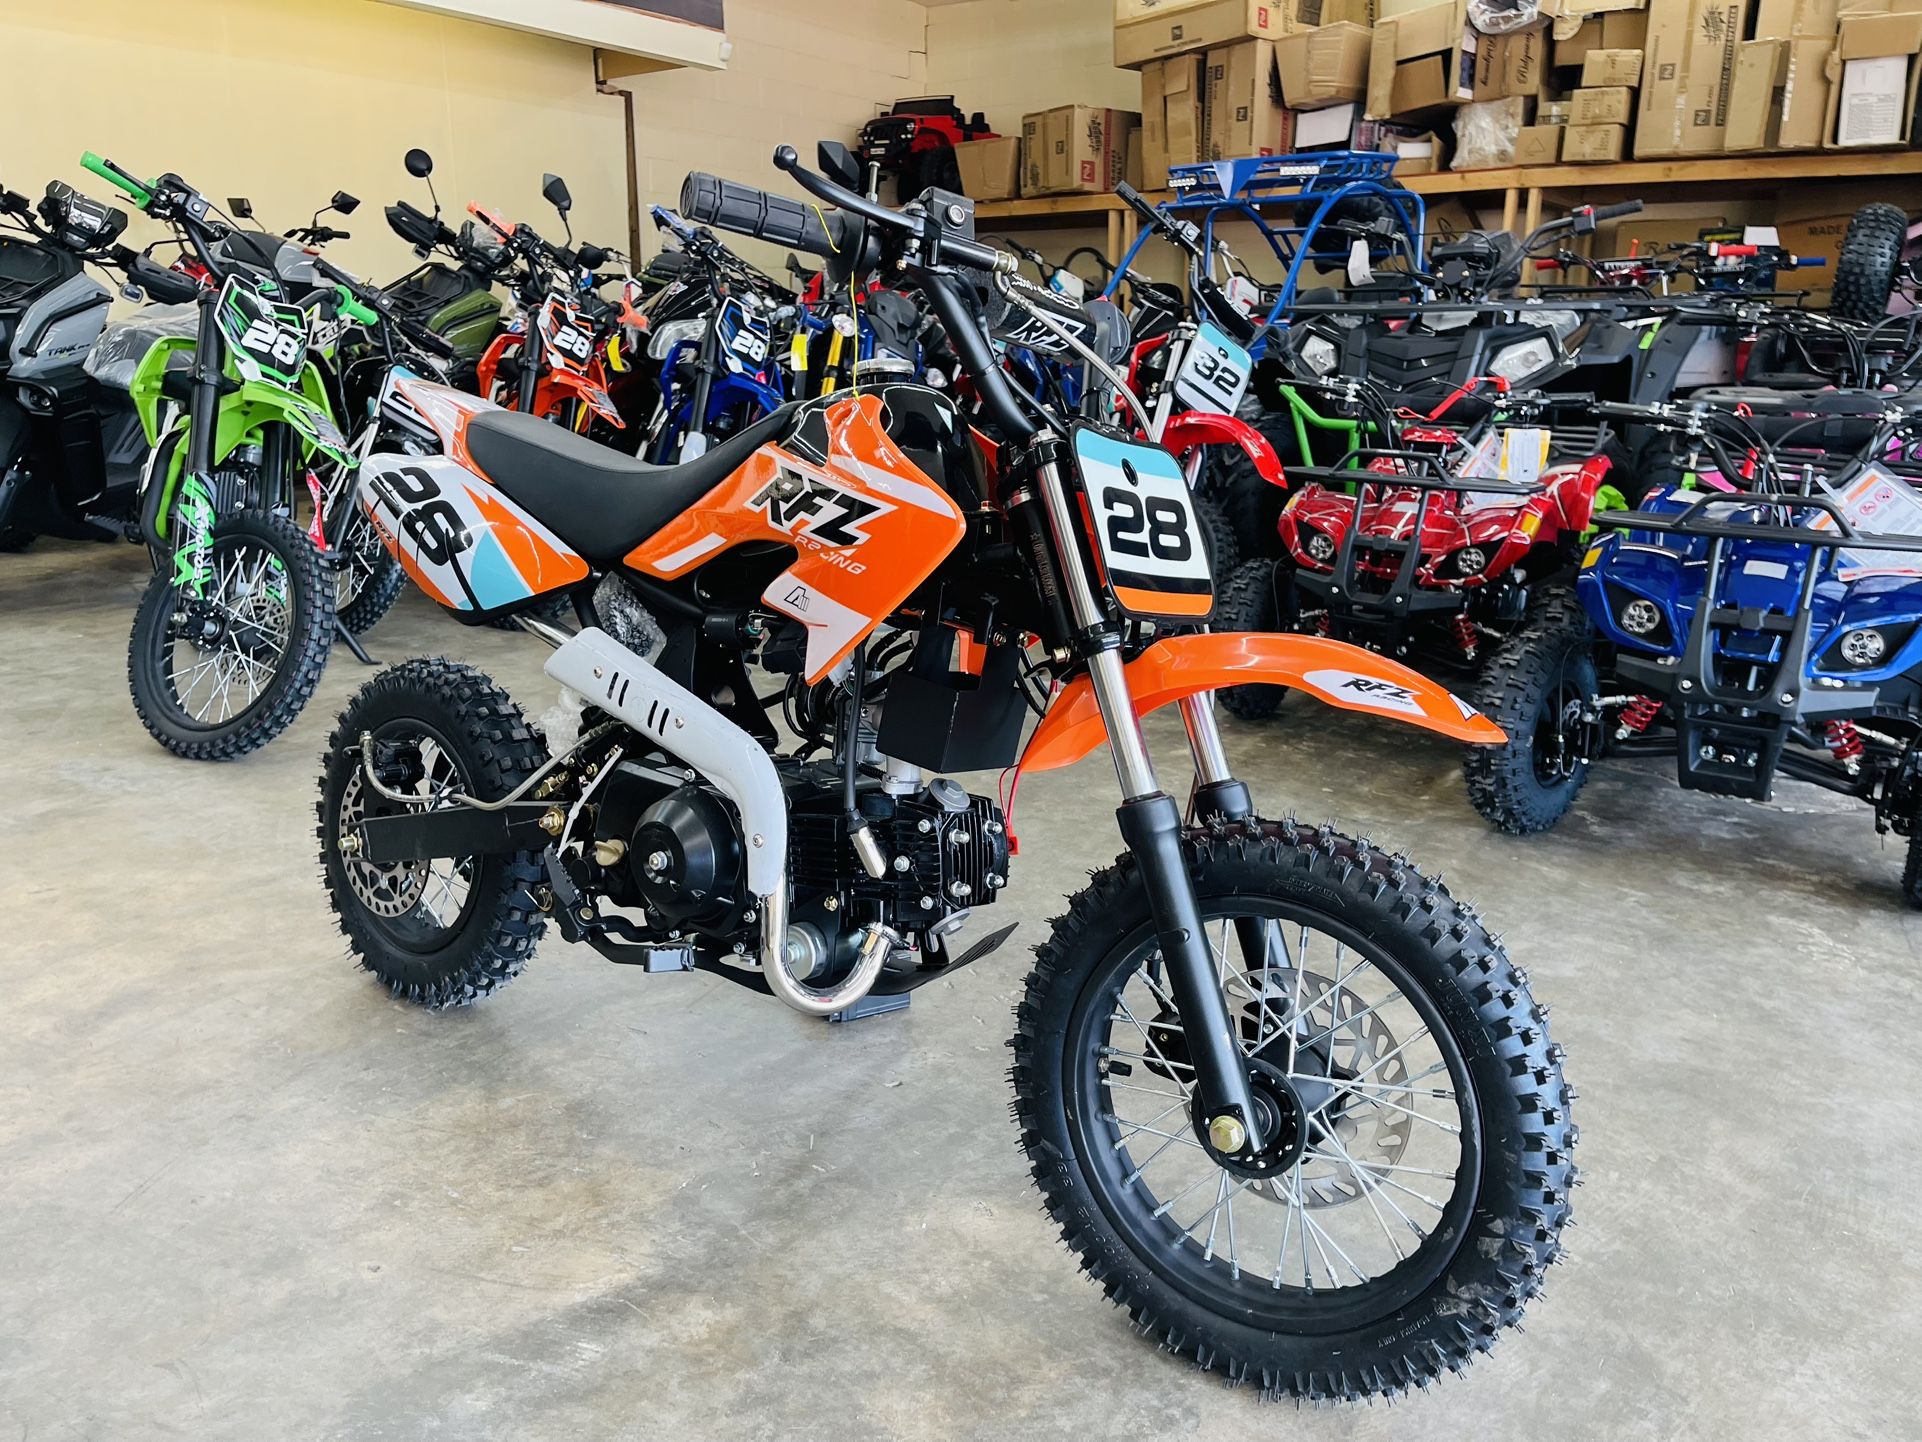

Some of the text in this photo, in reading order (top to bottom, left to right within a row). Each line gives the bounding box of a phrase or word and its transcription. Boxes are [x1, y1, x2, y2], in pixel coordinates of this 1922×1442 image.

[1807, 226, 1842, 236] MADE
[241, 319, 300, 365] 28
[553, 325, 590, 359] 28
[731, 329, 766, 362] 28
[1194, 350, 1240, 397] 32
[369, 467, 474, 566] 28
[746, 463, 888, 548] RFZ
[1103, 486, 1192, 561] 28
[1340, 676, 1417, 699] RFZ
